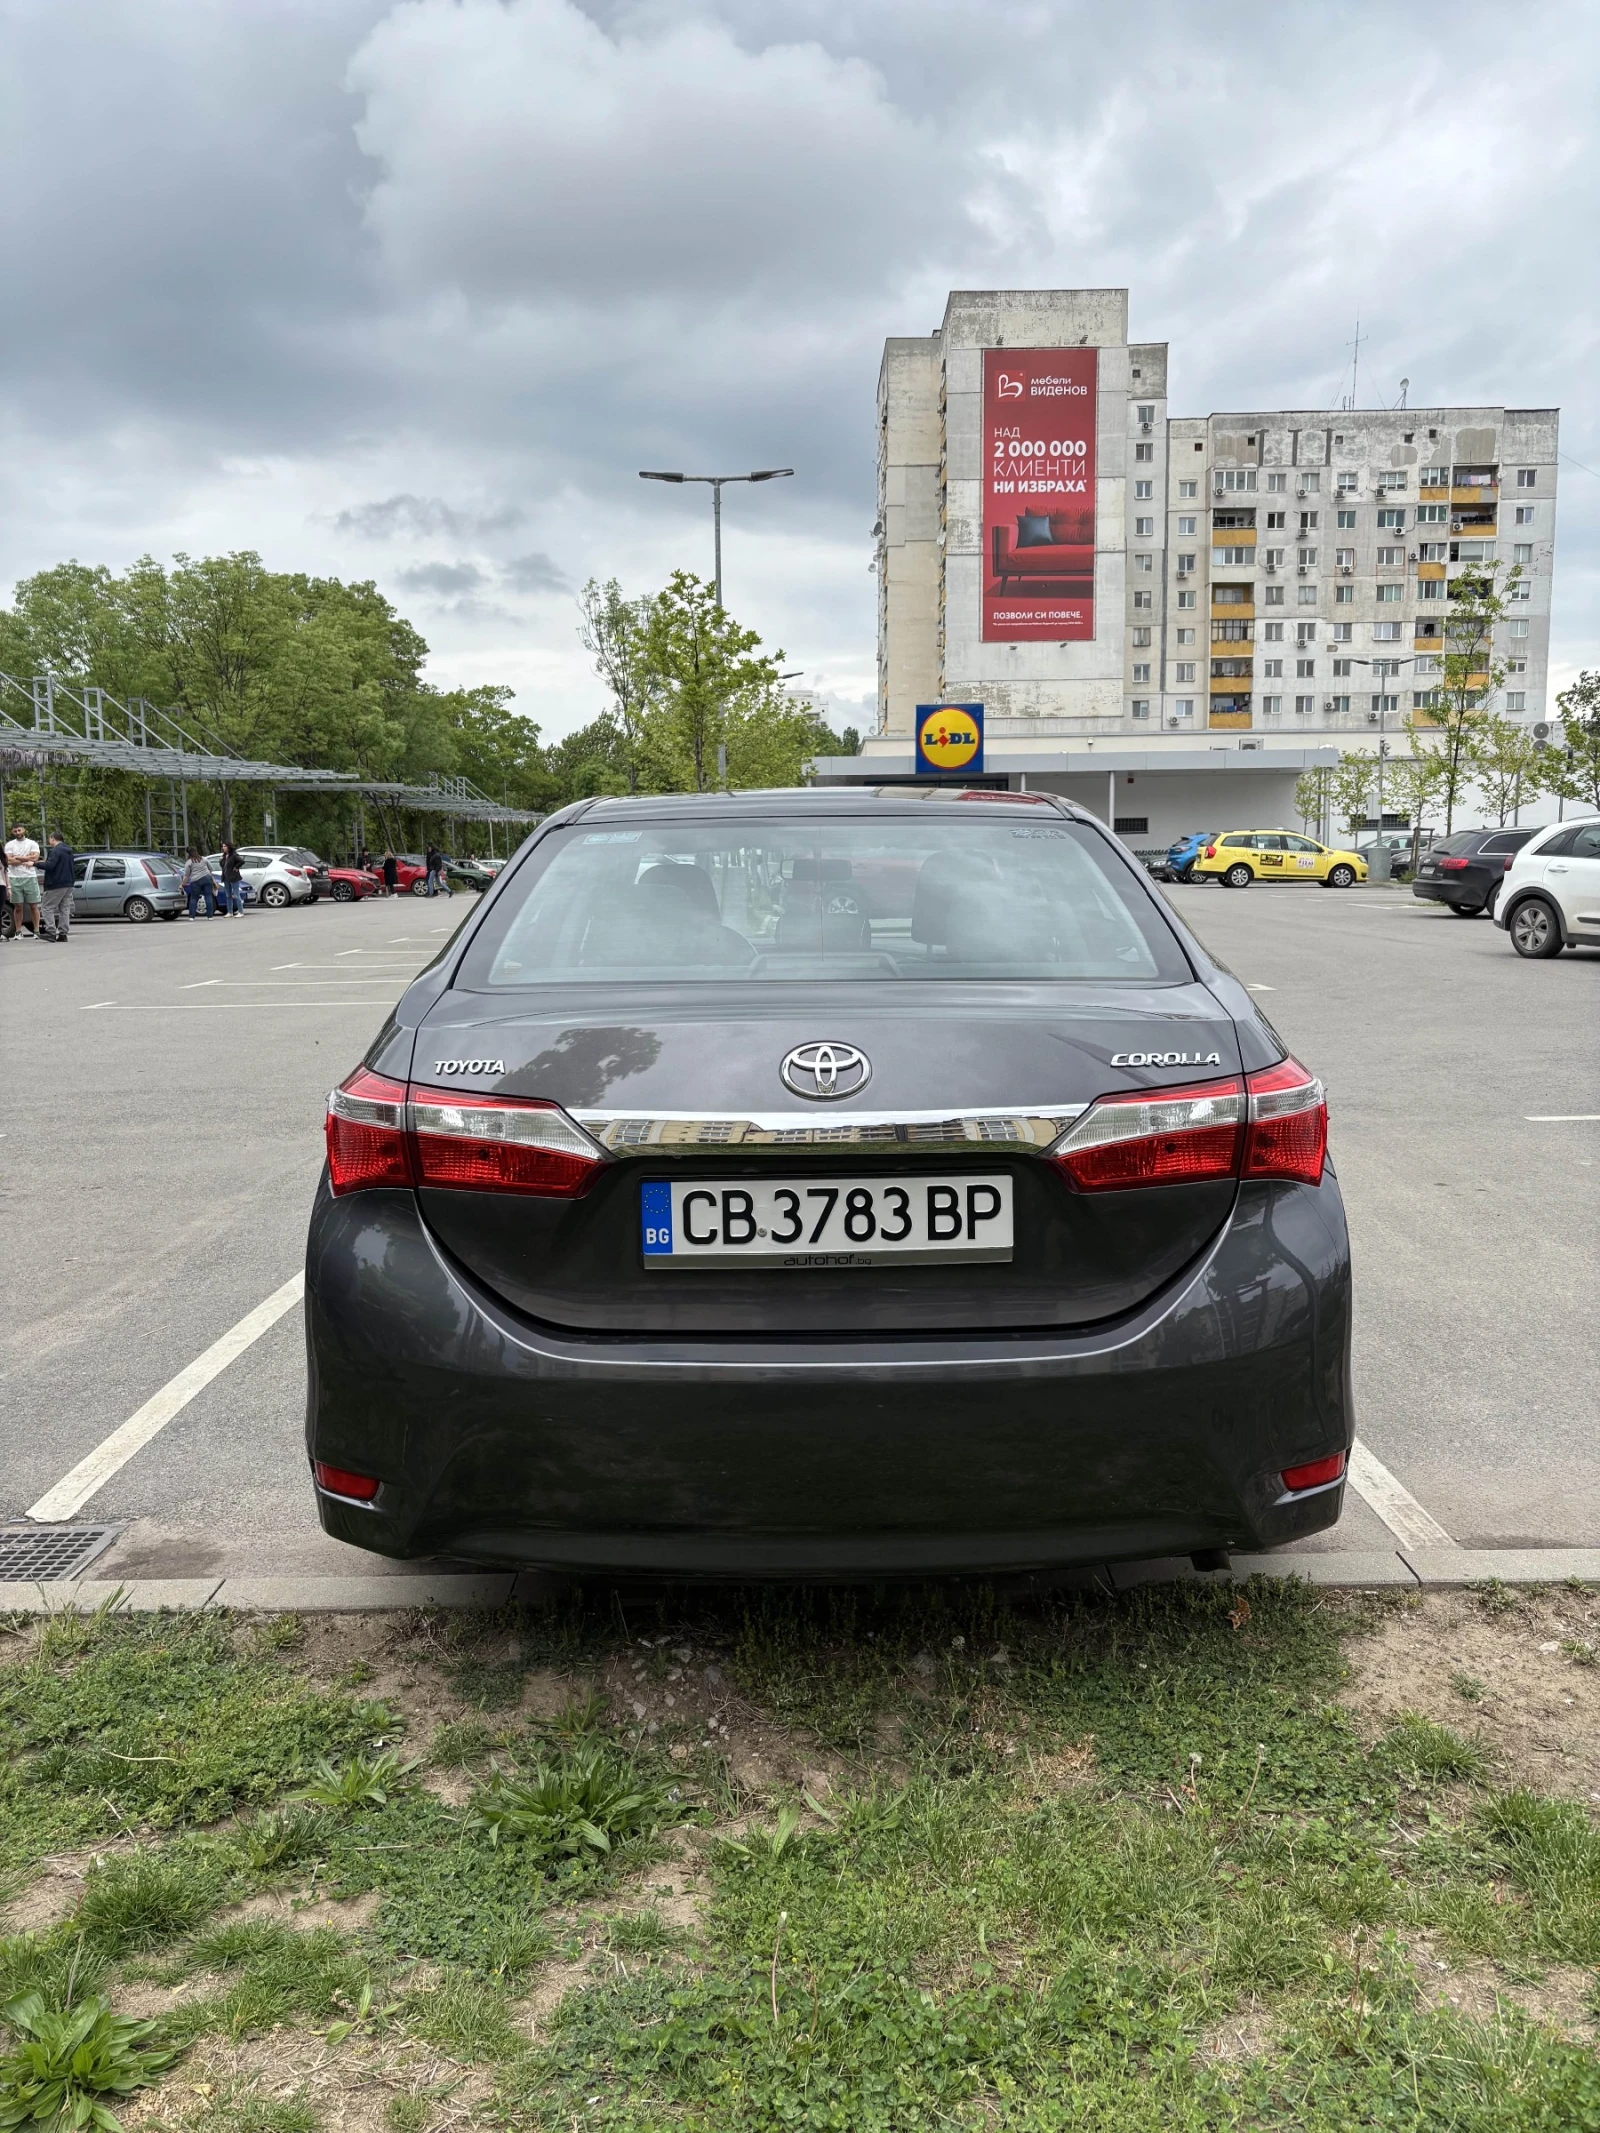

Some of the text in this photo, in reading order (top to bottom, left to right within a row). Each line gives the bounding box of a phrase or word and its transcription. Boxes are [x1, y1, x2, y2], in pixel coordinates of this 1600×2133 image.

[994, 427, 1021, 438] НАД
[994, 440, 1087, 457] 2 000 000
[993, 459, 1086, 477] КЛИЕНТИ
[993, 480, 1015, 493] НИ
[993, 610, 1083, 620] ПОЗВОЛИ СИ ПОВЕЧЕ.
[435, 1059, 506, 1075] TOYOTA
[1110, 1052, 1221, 1068] COROLLA
[682, 1184, 1002, 1245] CB 3783 BP
[646, 1227, 669, 1244] BG
[783, 1253, 872, 1266] autohof.bg
